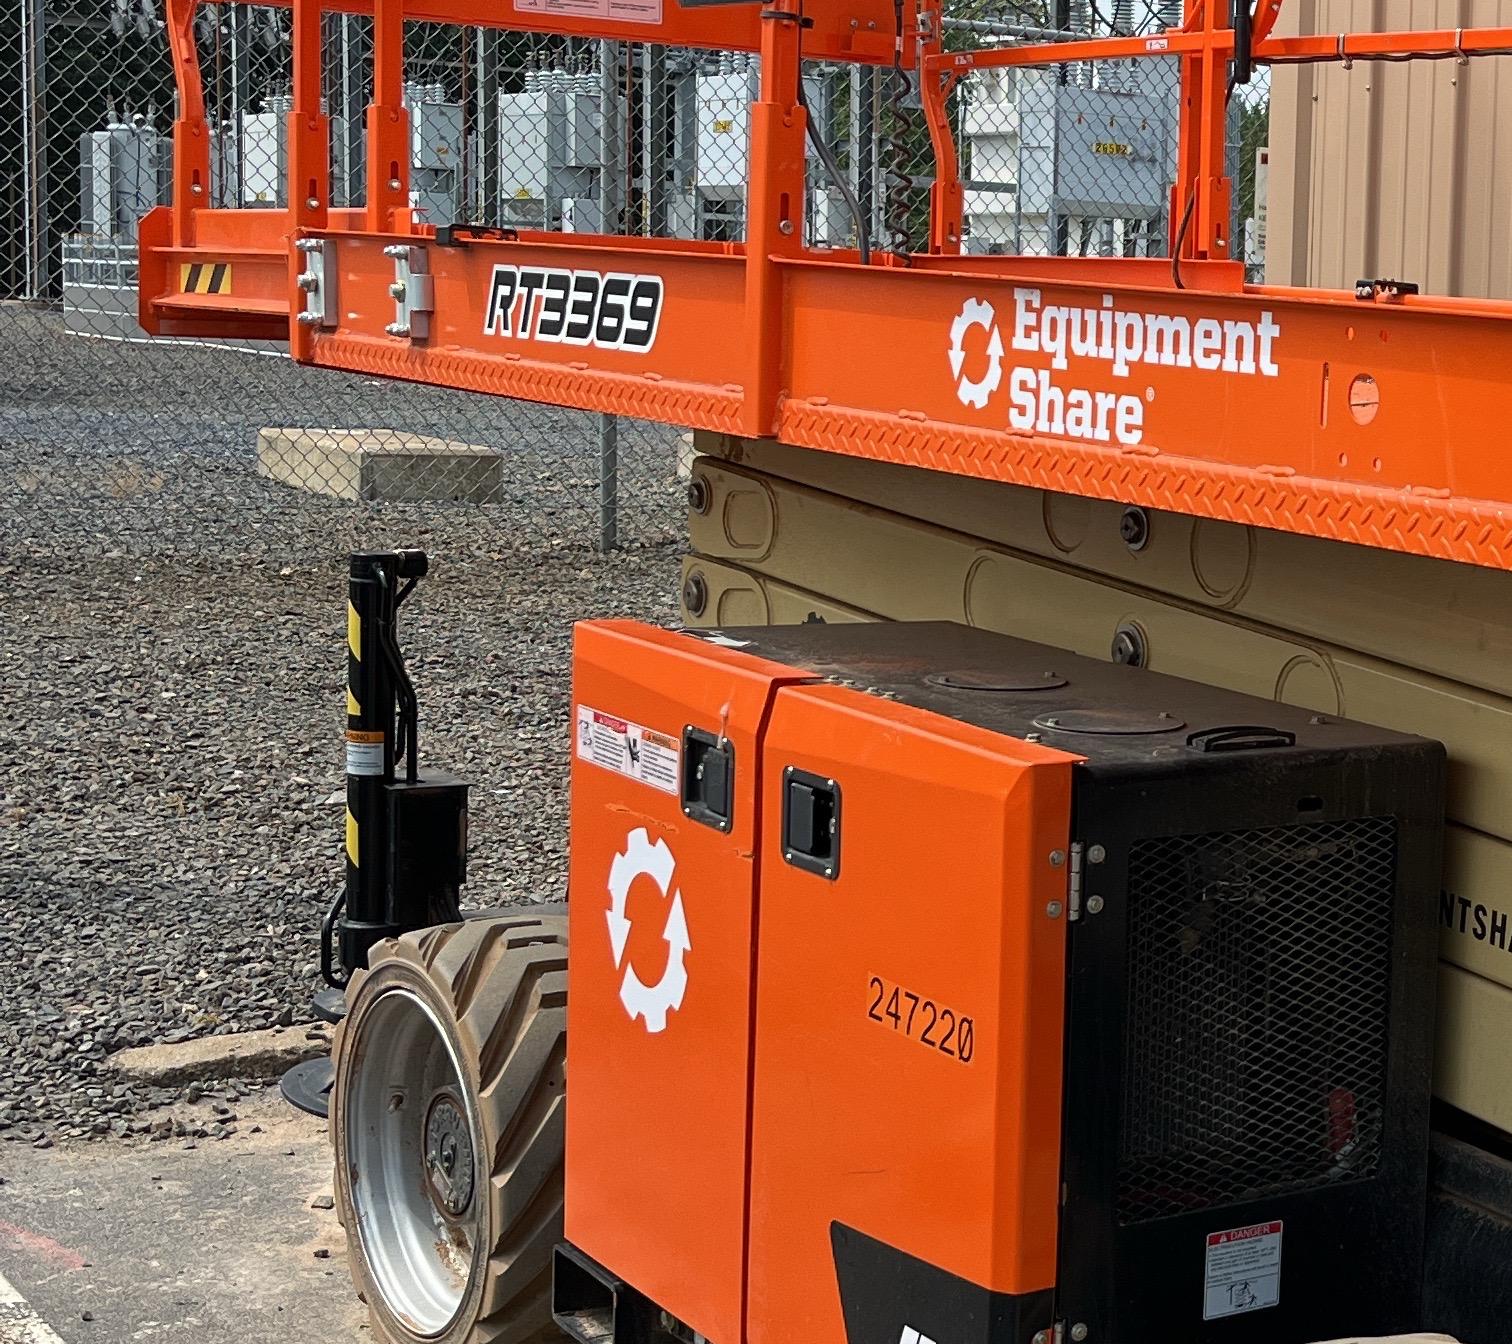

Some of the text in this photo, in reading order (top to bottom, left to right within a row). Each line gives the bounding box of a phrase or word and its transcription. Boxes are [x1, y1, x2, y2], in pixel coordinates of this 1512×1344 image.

[486, 266, 662, 350] RT3369
[1011, 287, 1281, 377] Equipment
[1008, 366, 1144, 445] Share
[868, 976, 974, 1063] 247220
[1229, 1224, 1271, 1241] DANGER
